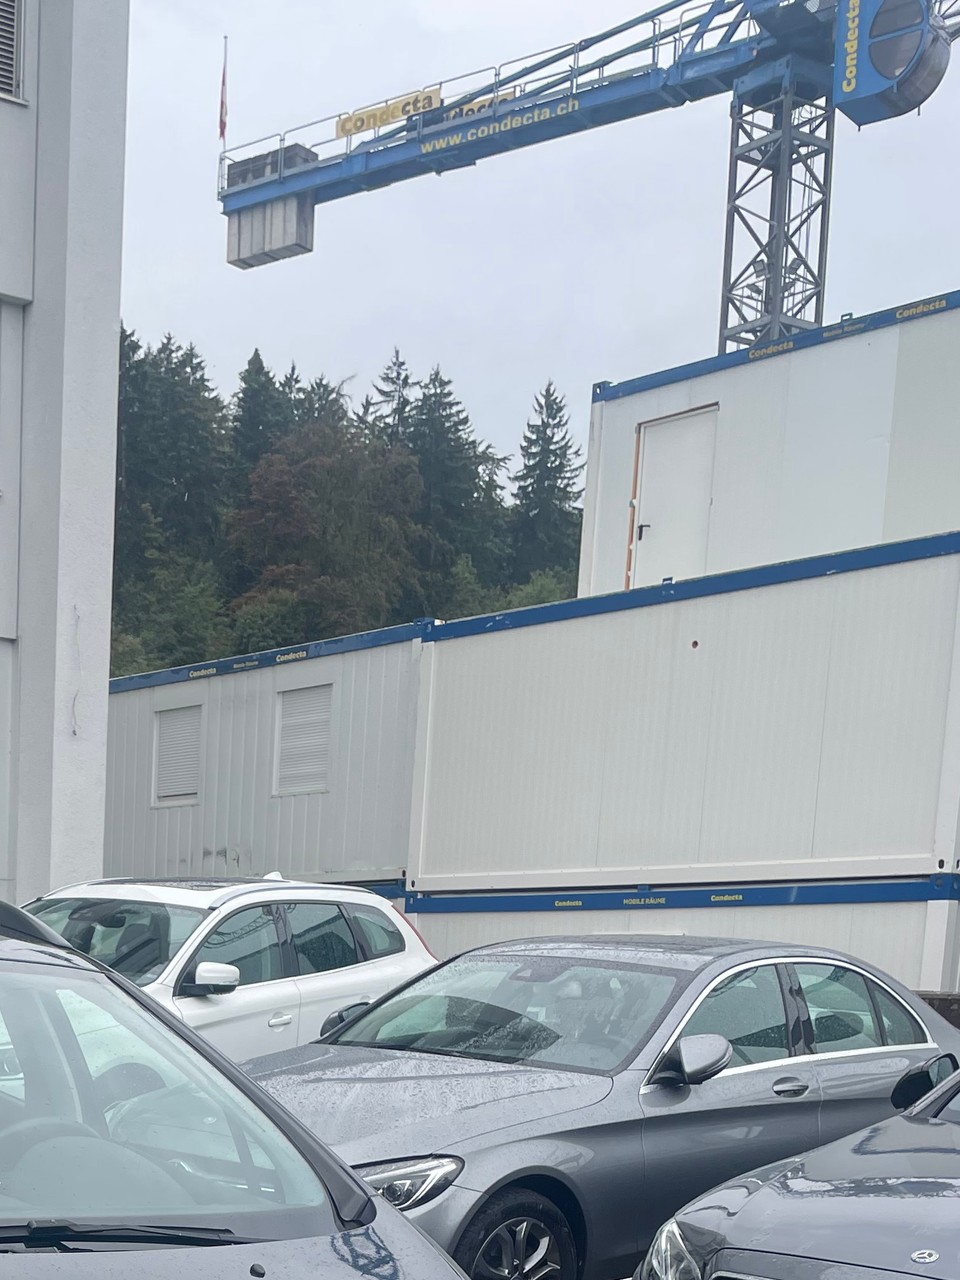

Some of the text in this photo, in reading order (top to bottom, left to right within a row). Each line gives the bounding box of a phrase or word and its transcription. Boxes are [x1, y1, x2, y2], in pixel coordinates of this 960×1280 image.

[340, 93, 434, 134] Condecta
[420, 98, 580, 154] www.condecta.ch
[895, 300, 946, 319] Condecta
[748, 341, 794, 359] Condecta
